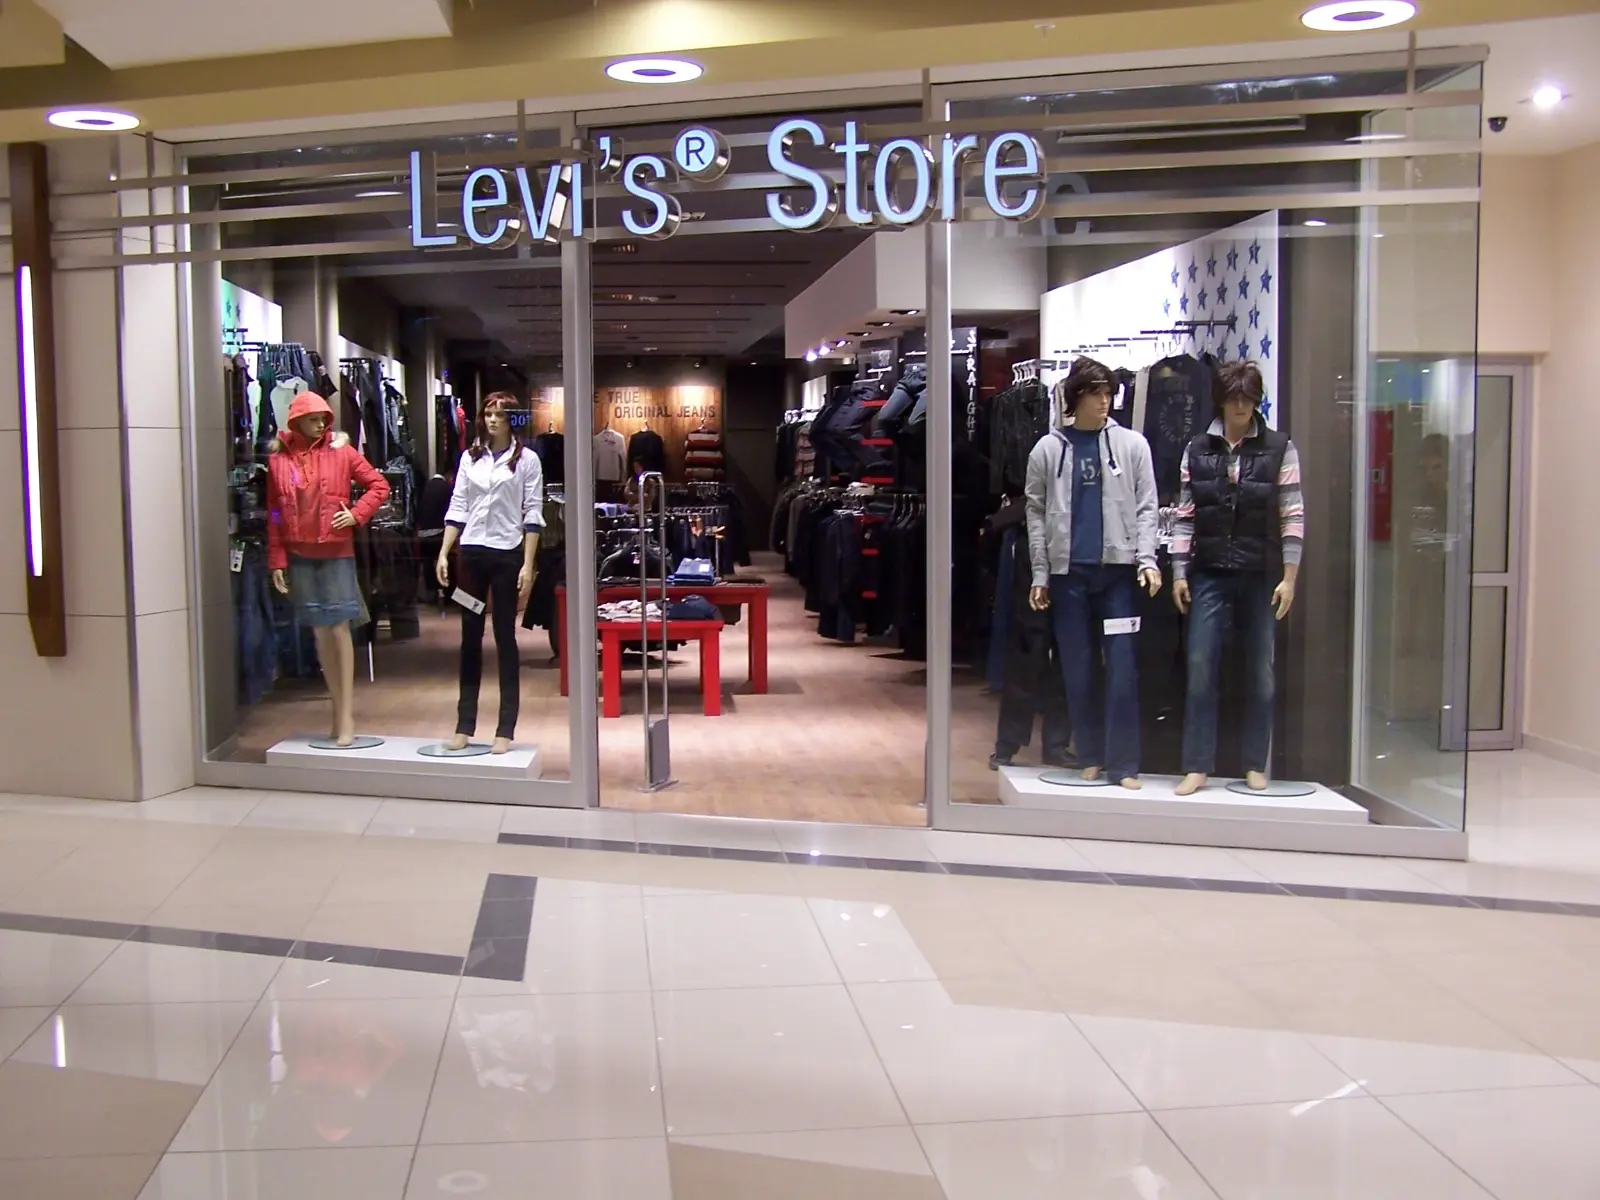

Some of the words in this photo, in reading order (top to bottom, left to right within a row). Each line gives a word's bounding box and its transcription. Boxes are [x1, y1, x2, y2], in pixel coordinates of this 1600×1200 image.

[766, 119, 1040, 228] Store
[608, 391, 639, 404] TRUE
[614, 405, 672, 419] ORIGINAL
[677, 405, 716, 418] JEANS
[966, 329, 976, 441] STRAIGHT
